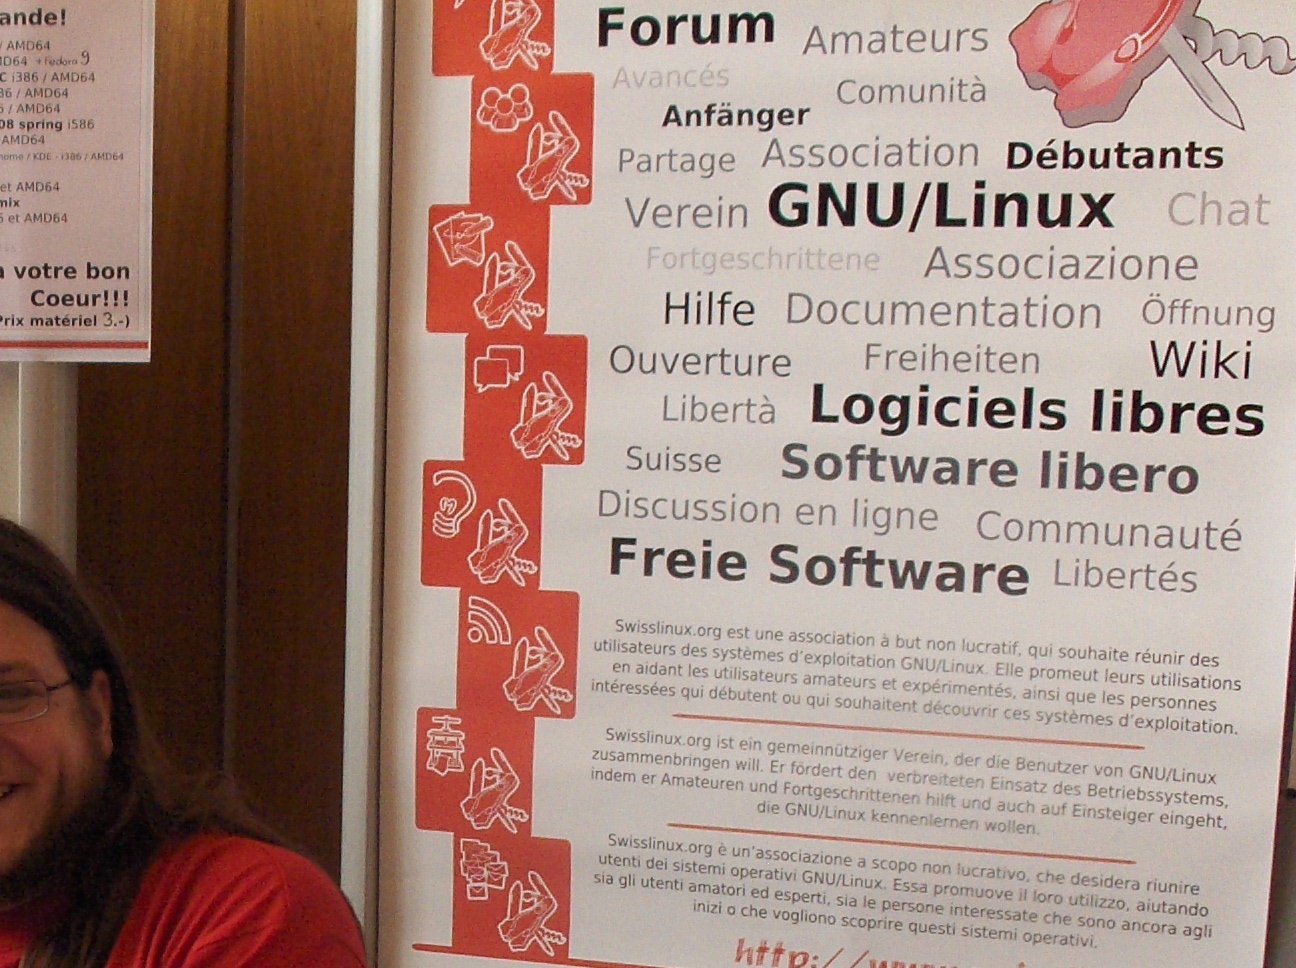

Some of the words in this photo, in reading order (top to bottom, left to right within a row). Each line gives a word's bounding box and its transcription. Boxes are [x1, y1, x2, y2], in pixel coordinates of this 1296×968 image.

[597, 6, 776, 48] Forum
[802, 24, 989, 56] Amateurs
[7, 41, 50, 51] AMD64
[12, 73, 38, 83] i386
[51, 73, 95, 83] AMD64
[612, 64, 730, 90] Avancés
[836, 77, 988, 106] Comunità
[17, 104, 60, 114] AMD64
[25, 88, 68, 99] AMD64
[19, 120, 62, 132] spring
[68, 120, 94, 130] i586
[661, 103, 810, 132] Anfänger
[2, 135, 45, 146] AMD64
[761, 136, 980, 169] Association
[1006, 141, 1224, 171] Débutants
[618, 148, 736, 178] Partage
[0, 183, 11, 193] et
[17, 183, 60, 193] AMD64
[9, 214, 19, 224] et
[25, 214, 68, 224] AMD64
[624, 196, 749, 230] Verein
[768, 180, 1116, 233] GNU/Linux
[1167, 192, 1271, 228] Chat
[14, 264, 77, 279] votre
[87, 262, 130, 279] bon
[646, 246, 881, 275] Fortgeschrittene
[924, 246, 1199, 281] Associazione
[31, 290, 129, 307] Coeur!!!
[663, 292, 756, 327] Hilfe
[786, 293, 1102, 330] Documentation
[30, 314, 97, 327] matériel
[1141, 298, 1276, 333] Öffnung
[609, 344, 793, 377] Ouverture
[864, 343, 1040, 374] Freiheiten
[1149, 340, 1252, 380] Wiki
[662, 394, 776, 425] Libertà
[810, 383, 1068, 437] Logiciels
[1090, 389, 1265, 437] libres
[625, 444, 722, 474] Suisse
[781, 443, 1019, 488] Software
[1040, 450, 1200, 496] libero
[598, 489, 780, 526] Discussion
[795, 502, 837, 526] en
[853, 499, 939, 537] ligne
[976, 509, 1243, 553] Communauté
[610, 536, 748, 582] Freie
[769, 542, 1031, 596] Software
[1053, 558, 1199, 594] Libertés
[615, 619, 722, 640] Swisslinux.org
[727, 627, 750, 639] est
[755, 629, 783, 642] une
[788, 630, 875, 647] association
[881, 634, 890, 647] à
[896, 634, 921, 650] but
[927, 639, 956, 651] non
[961, 638, 1022, 657] lucratif,
[1028, 644, 1053, 659] qui
[1058, 645, 1129, 662] souhaite
[1135, 648, 1183, 665] réunir
[1190, 652, 1220, 667] des
